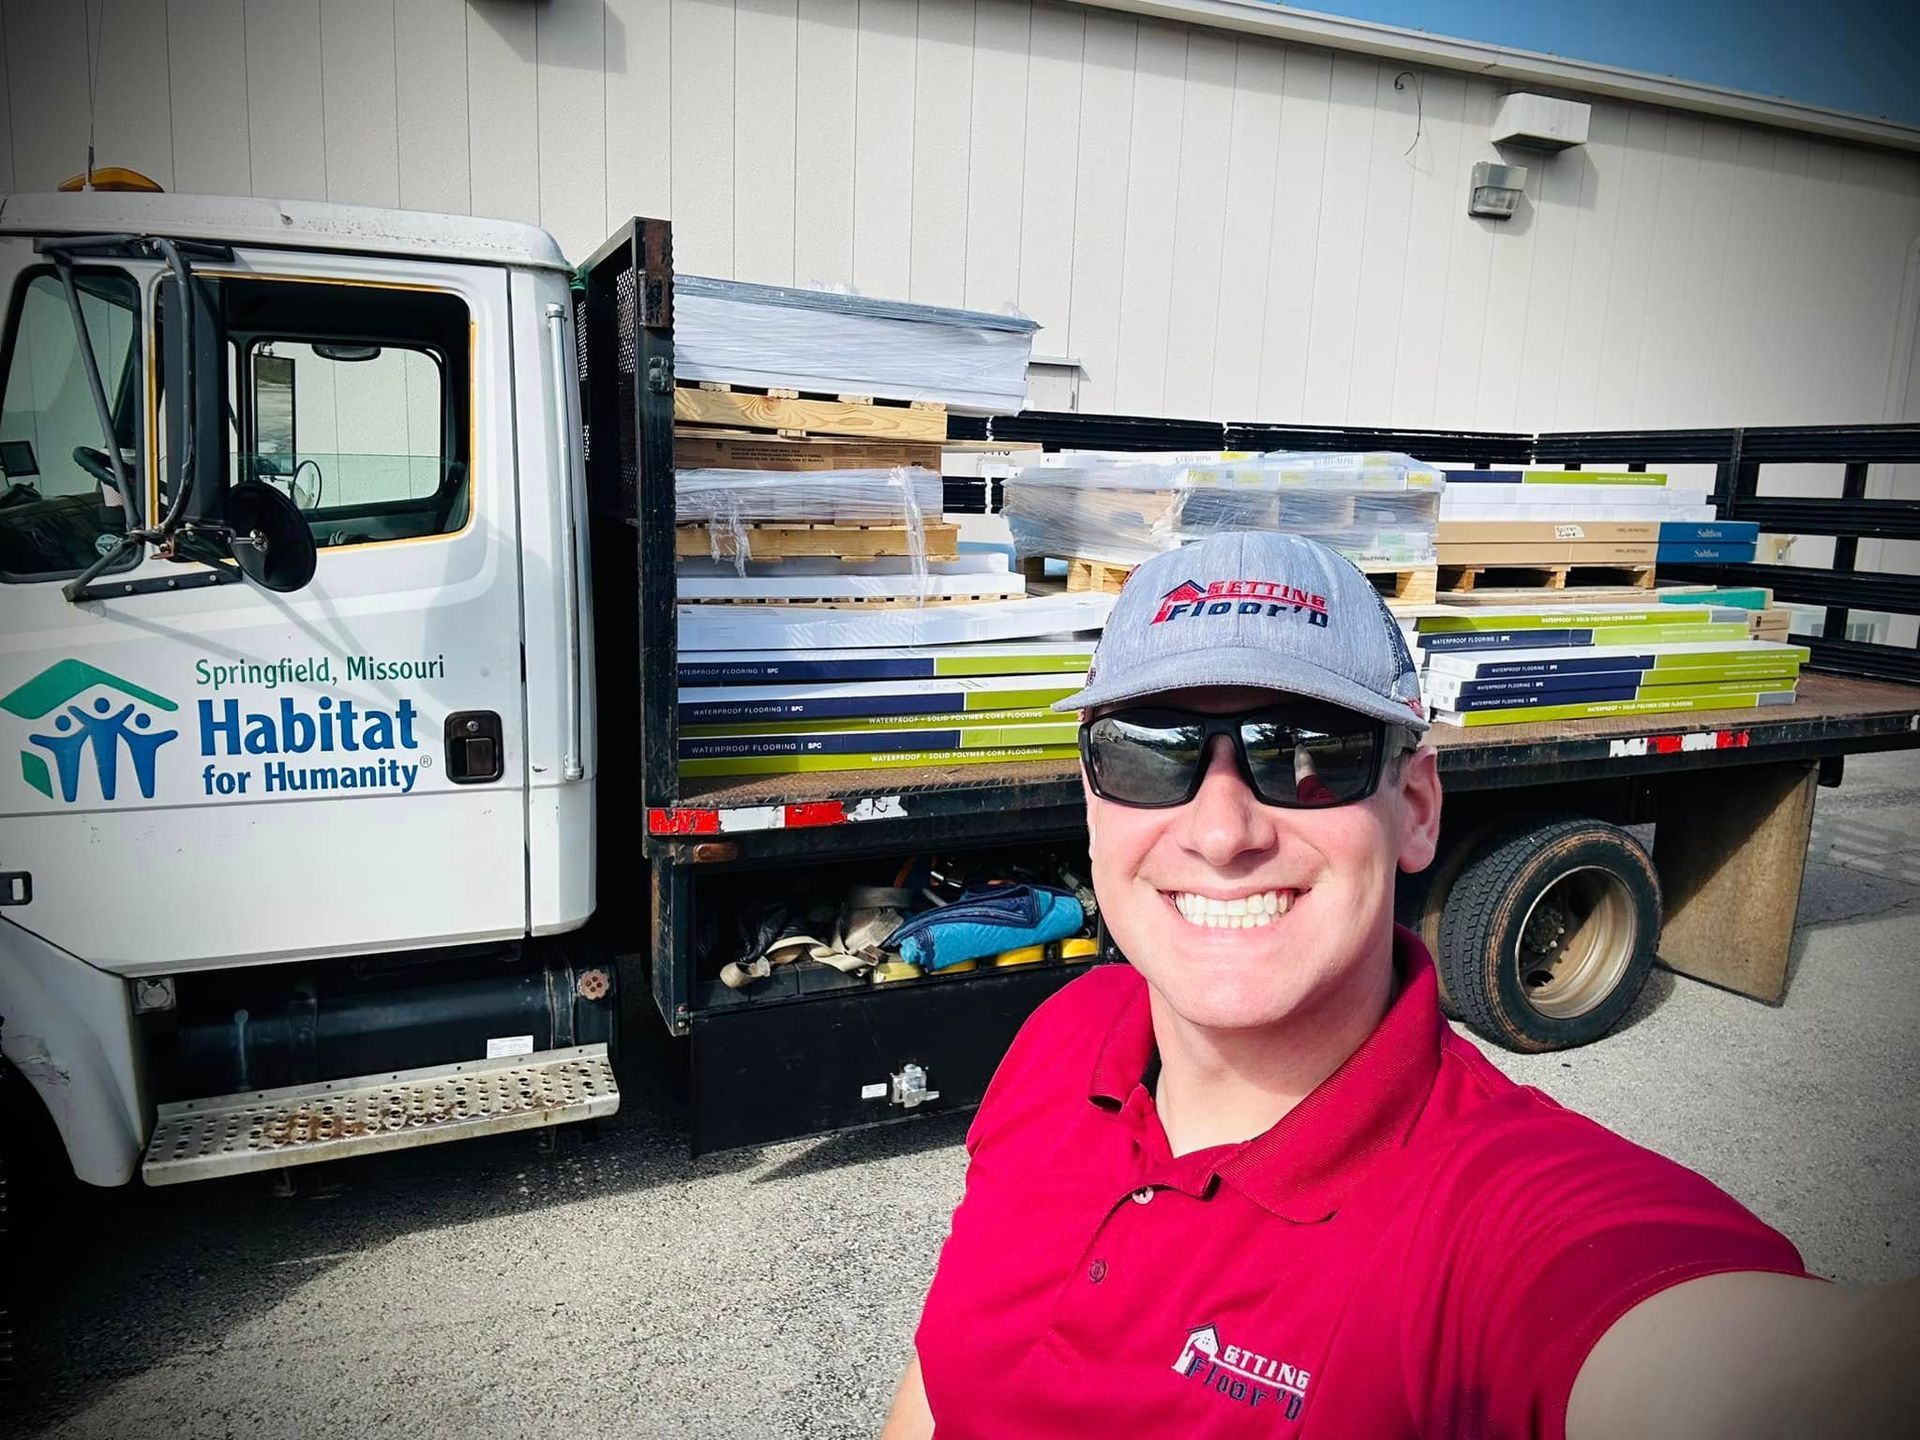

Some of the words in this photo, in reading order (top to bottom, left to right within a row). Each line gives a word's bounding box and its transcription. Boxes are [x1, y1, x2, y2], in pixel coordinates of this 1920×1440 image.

[1207, 580, 1326, 608] GETTING
[195, 657, 338, 690] Springfield,
[346, 654, 445, 680] Missouri
[197, 696, 419, 756] Habitat
[693, 708, 741, 716] WATERPROOF
[869, 716, 919, 724] WATERPROOF
[927, 714, 949, 722] SOLID
[950, 713, 984, 721] POLYMER
[1007, 711, 1043, 719] FLOORING
[692, 745, 750, 753] WATERPROOF
[752, 743, 796, 751] FLOORING
[871, 754, 920, 762] WATERPROOF
[929, 752, 950, 760] SOLID
[987, 749, 1006, 757] CORE
[1008, 748, 1044, 756] FLOORING
[203, 763, 250, 795] for
[1223, 1344, 1311, 1390] GETTING
